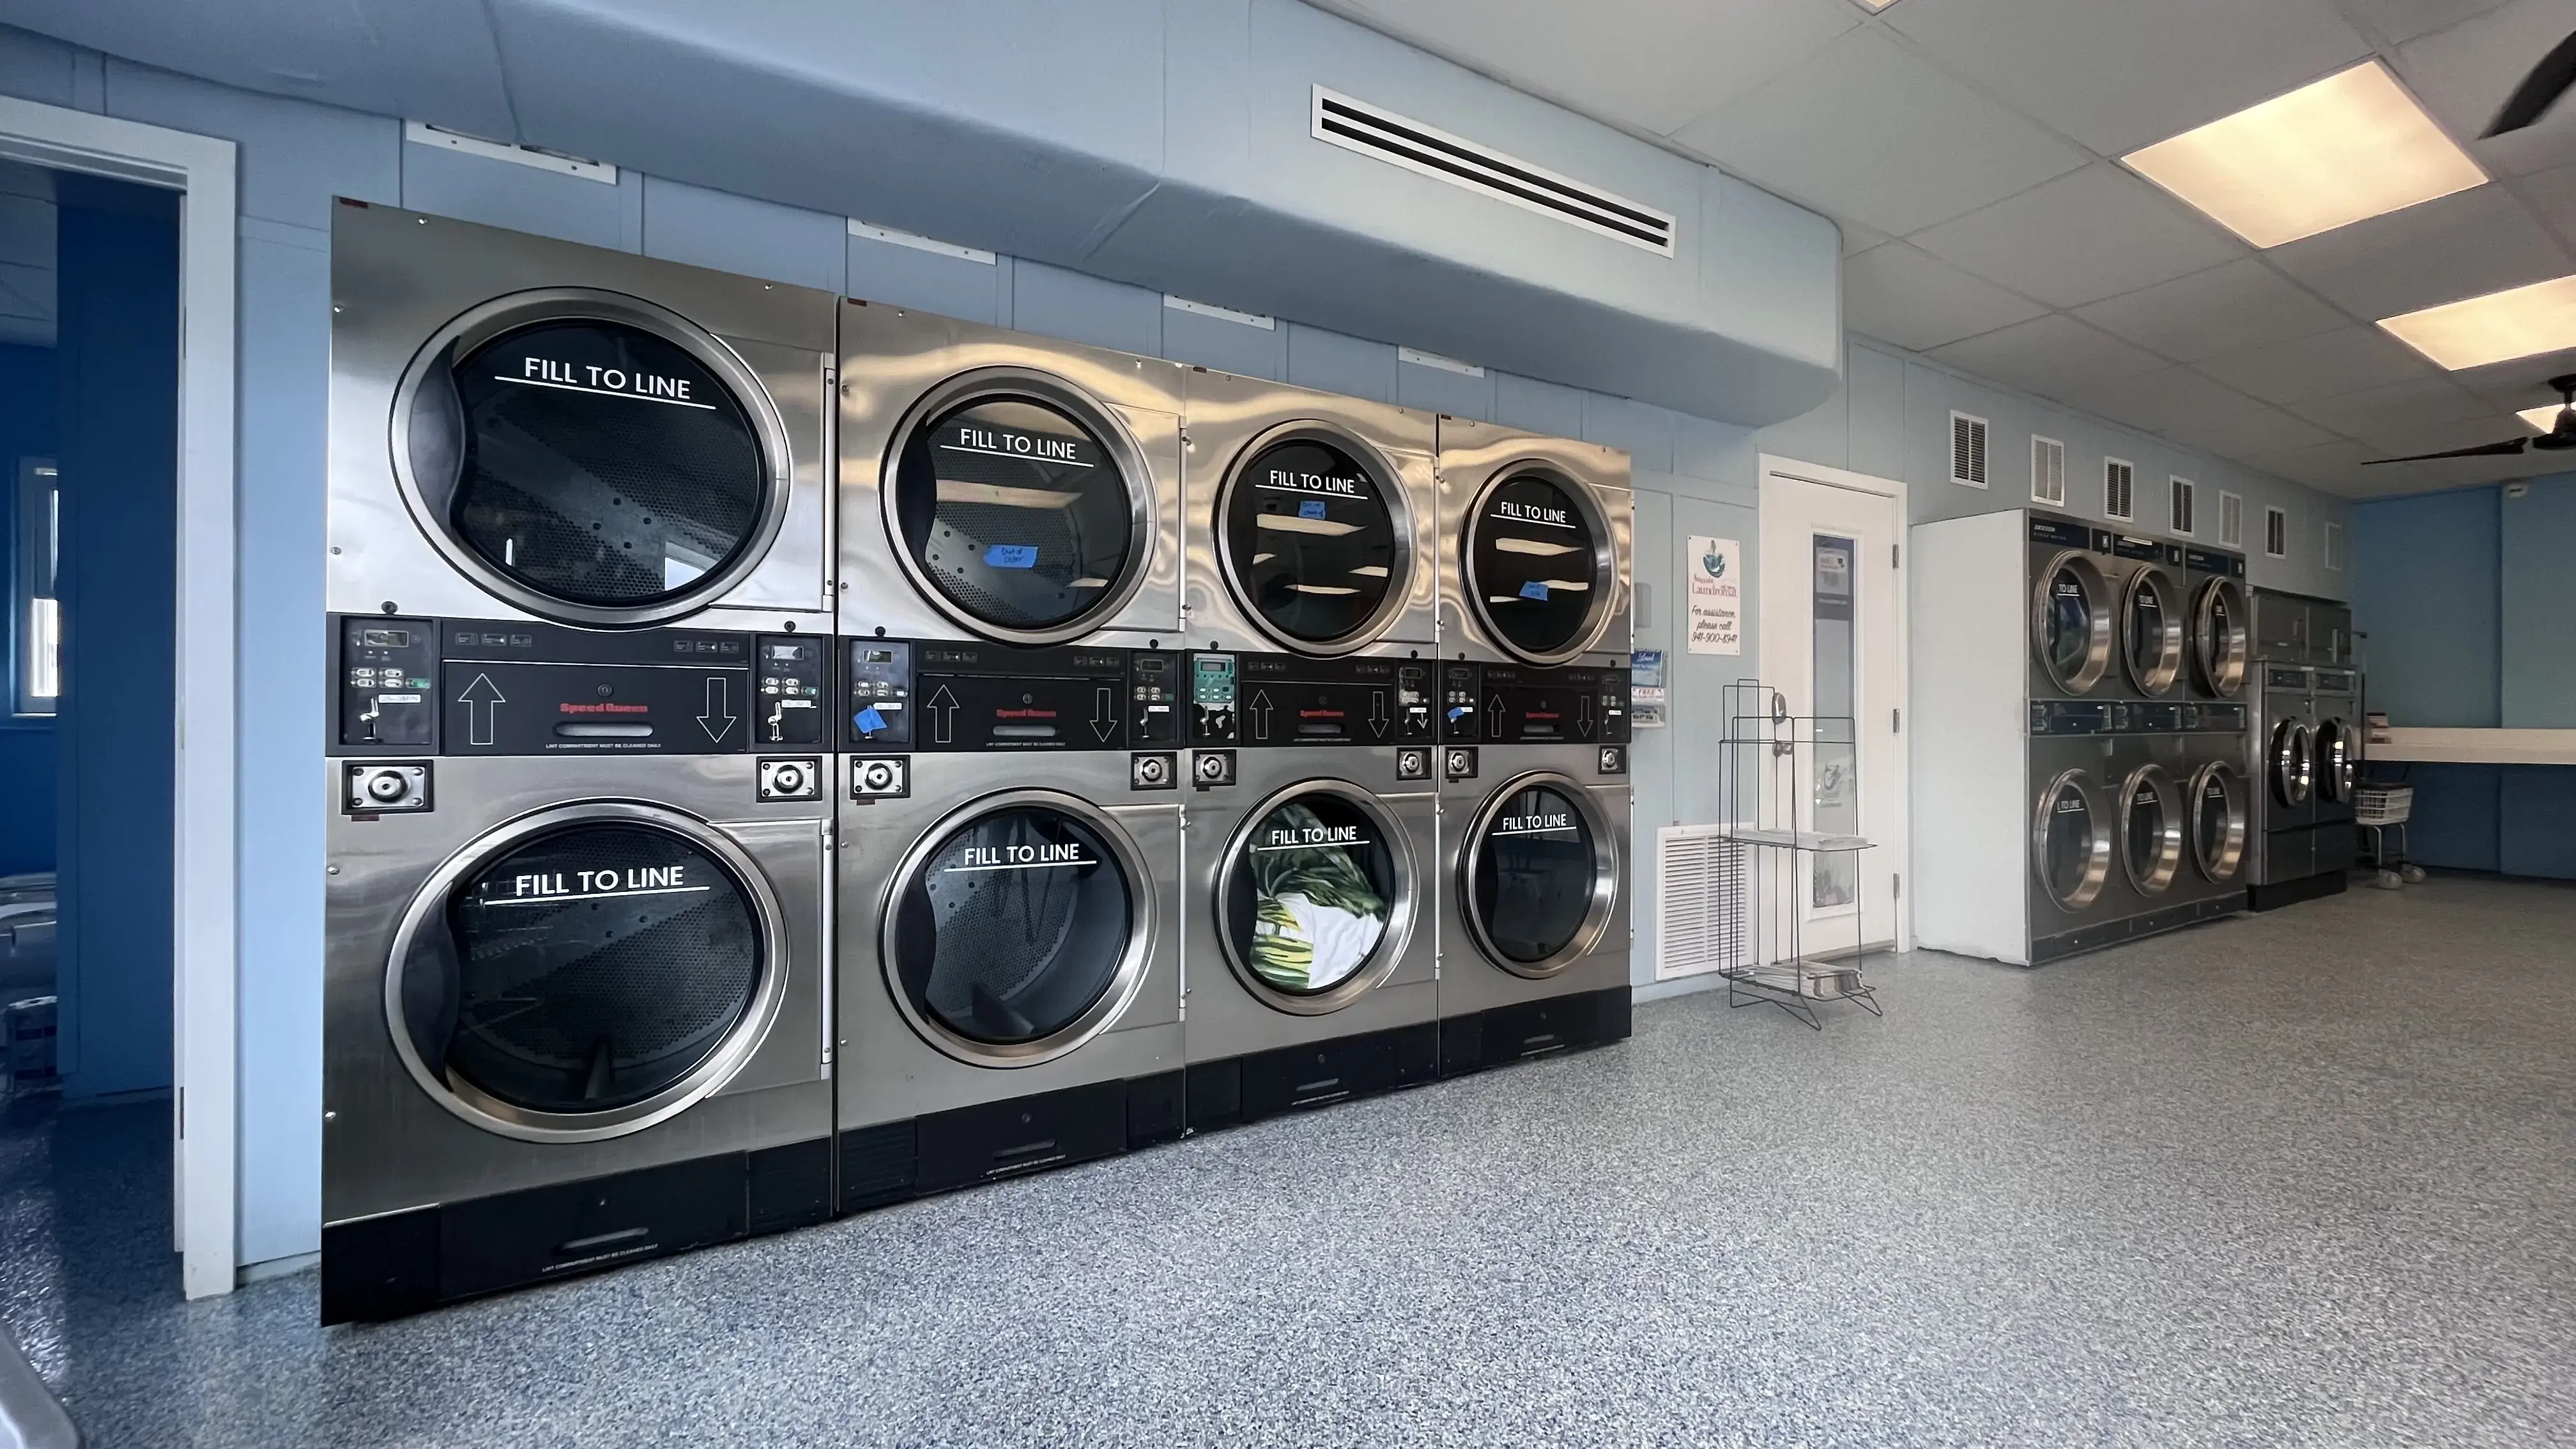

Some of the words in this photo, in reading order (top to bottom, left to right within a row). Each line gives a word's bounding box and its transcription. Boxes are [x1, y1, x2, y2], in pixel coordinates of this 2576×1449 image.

[525, 357, 578, 383] FILL
[586, 365, 626, 389] TO
[636, 372, 691, 399] LINE
[961, 428, 997, 449] FILL
[1002, 434, 1031, 453] TO
[1037, 438, 1076, 459] LINE
[1270, 470, 1297, 487] FILL
[1300, 473, 1322, 489] TO
[1326, 477, 1354, 493] LINE
[1501, 502, 1522, 517] FILL
[1524, 505, 1541, 519] TO
[1544, 508, 1566, 523] LINE
[1692, 583, 1737, 597] Laundromat
[1691, 604, 1701, 615] For
[1696, 619, 1717, 631] please
[1719, 621, 1732, 631] call
[560, 703, 604, 714] Speed
[2061, 801, 2068, 809] TO
[1503, 817, 1523, 831] FILL
[1526, 815, 1542, 829] TO
[1544, 814, 1567, 827] LINE
[1271, 829, 1299, 845] FILL
[1302, 827, 1324, 843] TO
[1327, 826, 1357, 841] LINE
[965, 847, 1001, 866] FILL
[1006, 845, 1034, 862] TO
[1040, 843, 1079, 861] LINE
[516, 873, 569, 896] FILL
[577, 870, 619, 892] TO
[627, 866, 684, 889] LINE
